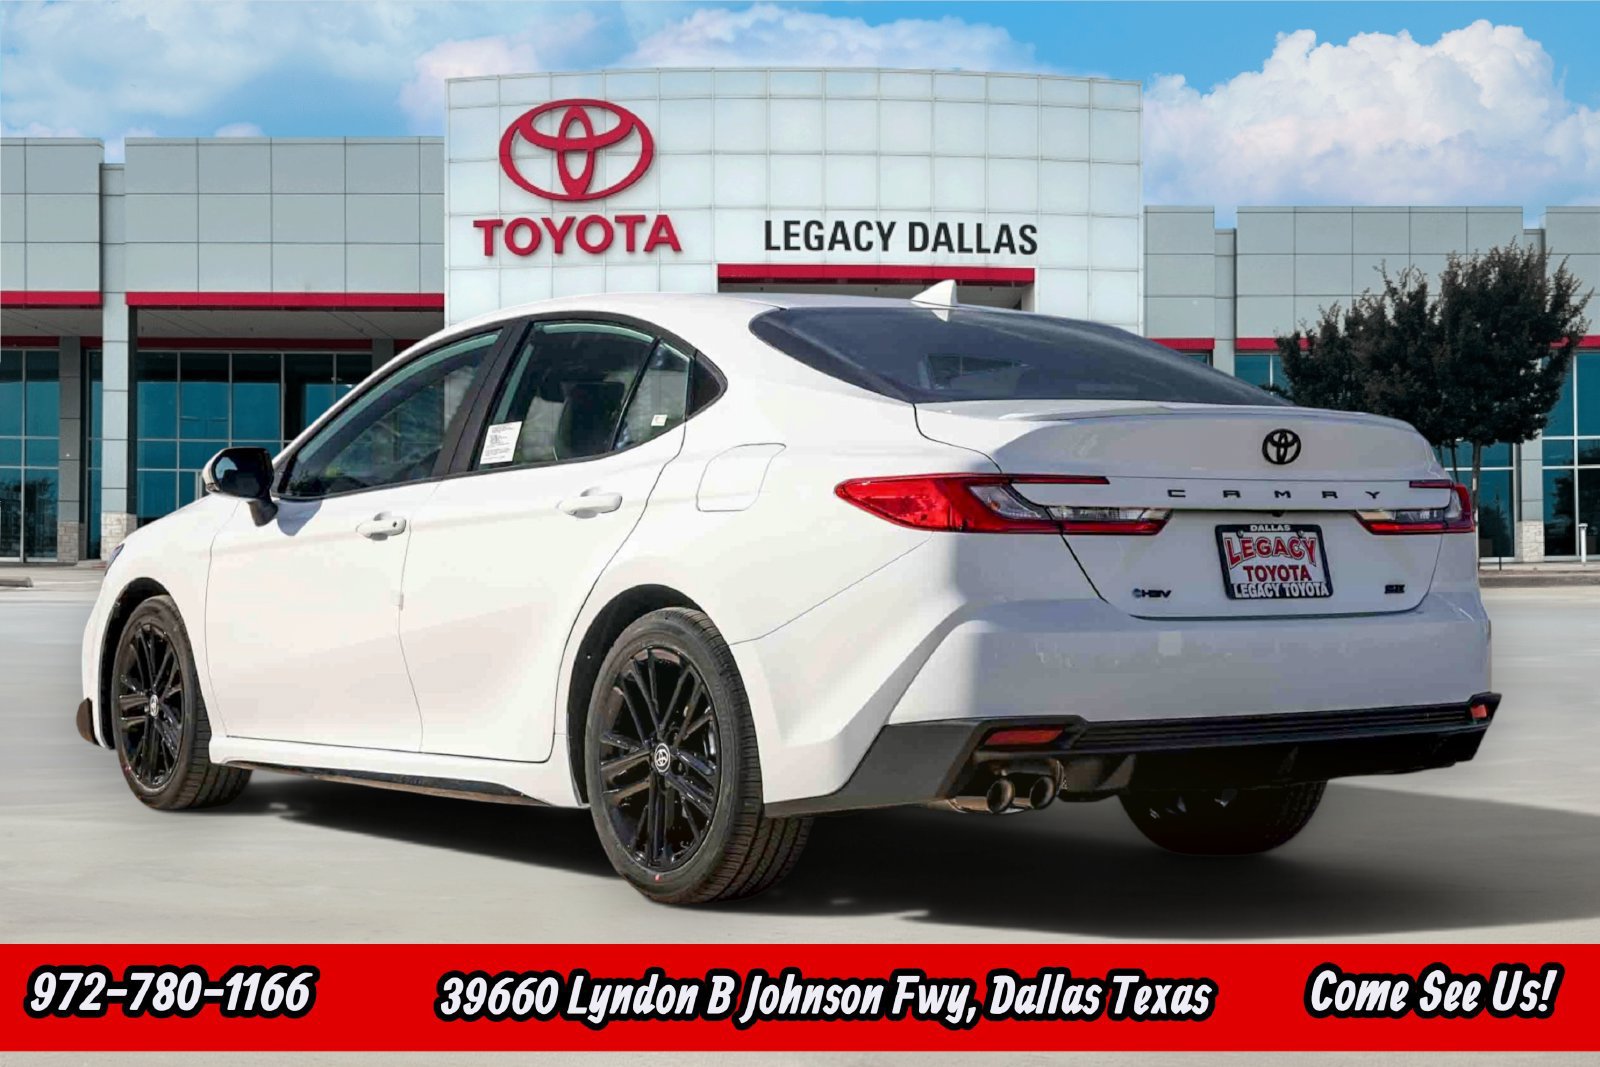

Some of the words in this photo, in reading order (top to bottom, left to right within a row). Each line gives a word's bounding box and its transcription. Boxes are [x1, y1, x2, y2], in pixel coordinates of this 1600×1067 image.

[473, 213, 682, 257] TOYOTA
[764, 219, 898, 253] LEGACY
[908, 221, 1039, 255] DALLAS
[1166, 488, 1381, 500] CAMRY
[1249, 524, 1291, 532] DALLAS
[1223, 536, 1318, 570] LEGACY
[1243, 564, 1313, 582] TOYOTA
[1233, 582, 1281, 599] LEGACY
[1283, 582, 1330, 598] TOYOTA
